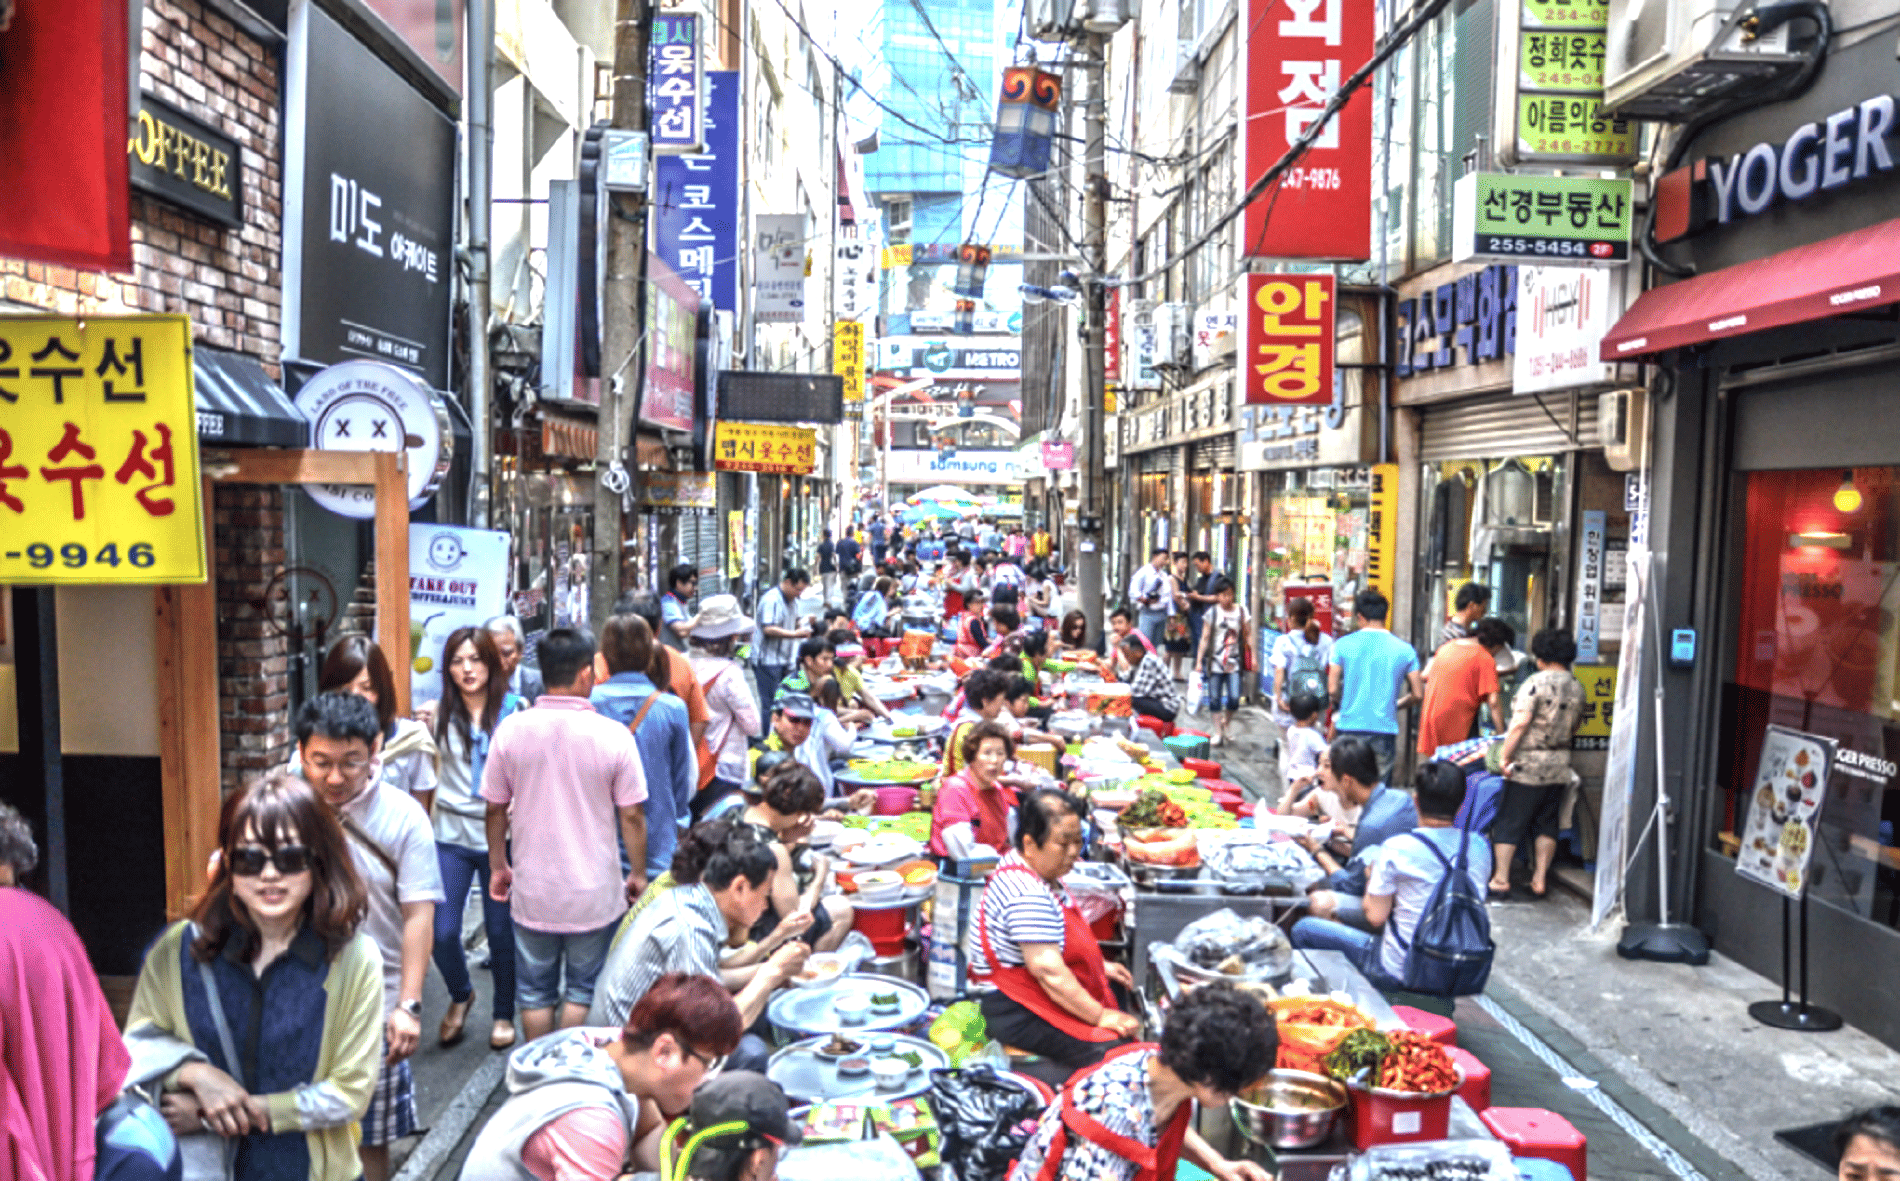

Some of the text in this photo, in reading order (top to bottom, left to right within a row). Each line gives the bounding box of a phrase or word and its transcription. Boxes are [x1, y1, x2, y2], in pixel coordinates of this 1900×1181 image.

[658, 44, 695, 139] 옷수선
[129, 109, 233, 201] OFFEE
[1710, 93, 1895, 224] YOGER
[330, 172, 384, 258] 미도
[1485, 188, 1625, 229] 선경부동산
[1490, 237, 1585, 256] 255-5454
[1255, 281, 1329, 398] 안경
[356, 379, 379, 391] THE
[929, 460, 998, 473] samsung
[5, 541, 156, 570] -9946
[1858, 753, 1897, 777] PRESSO
